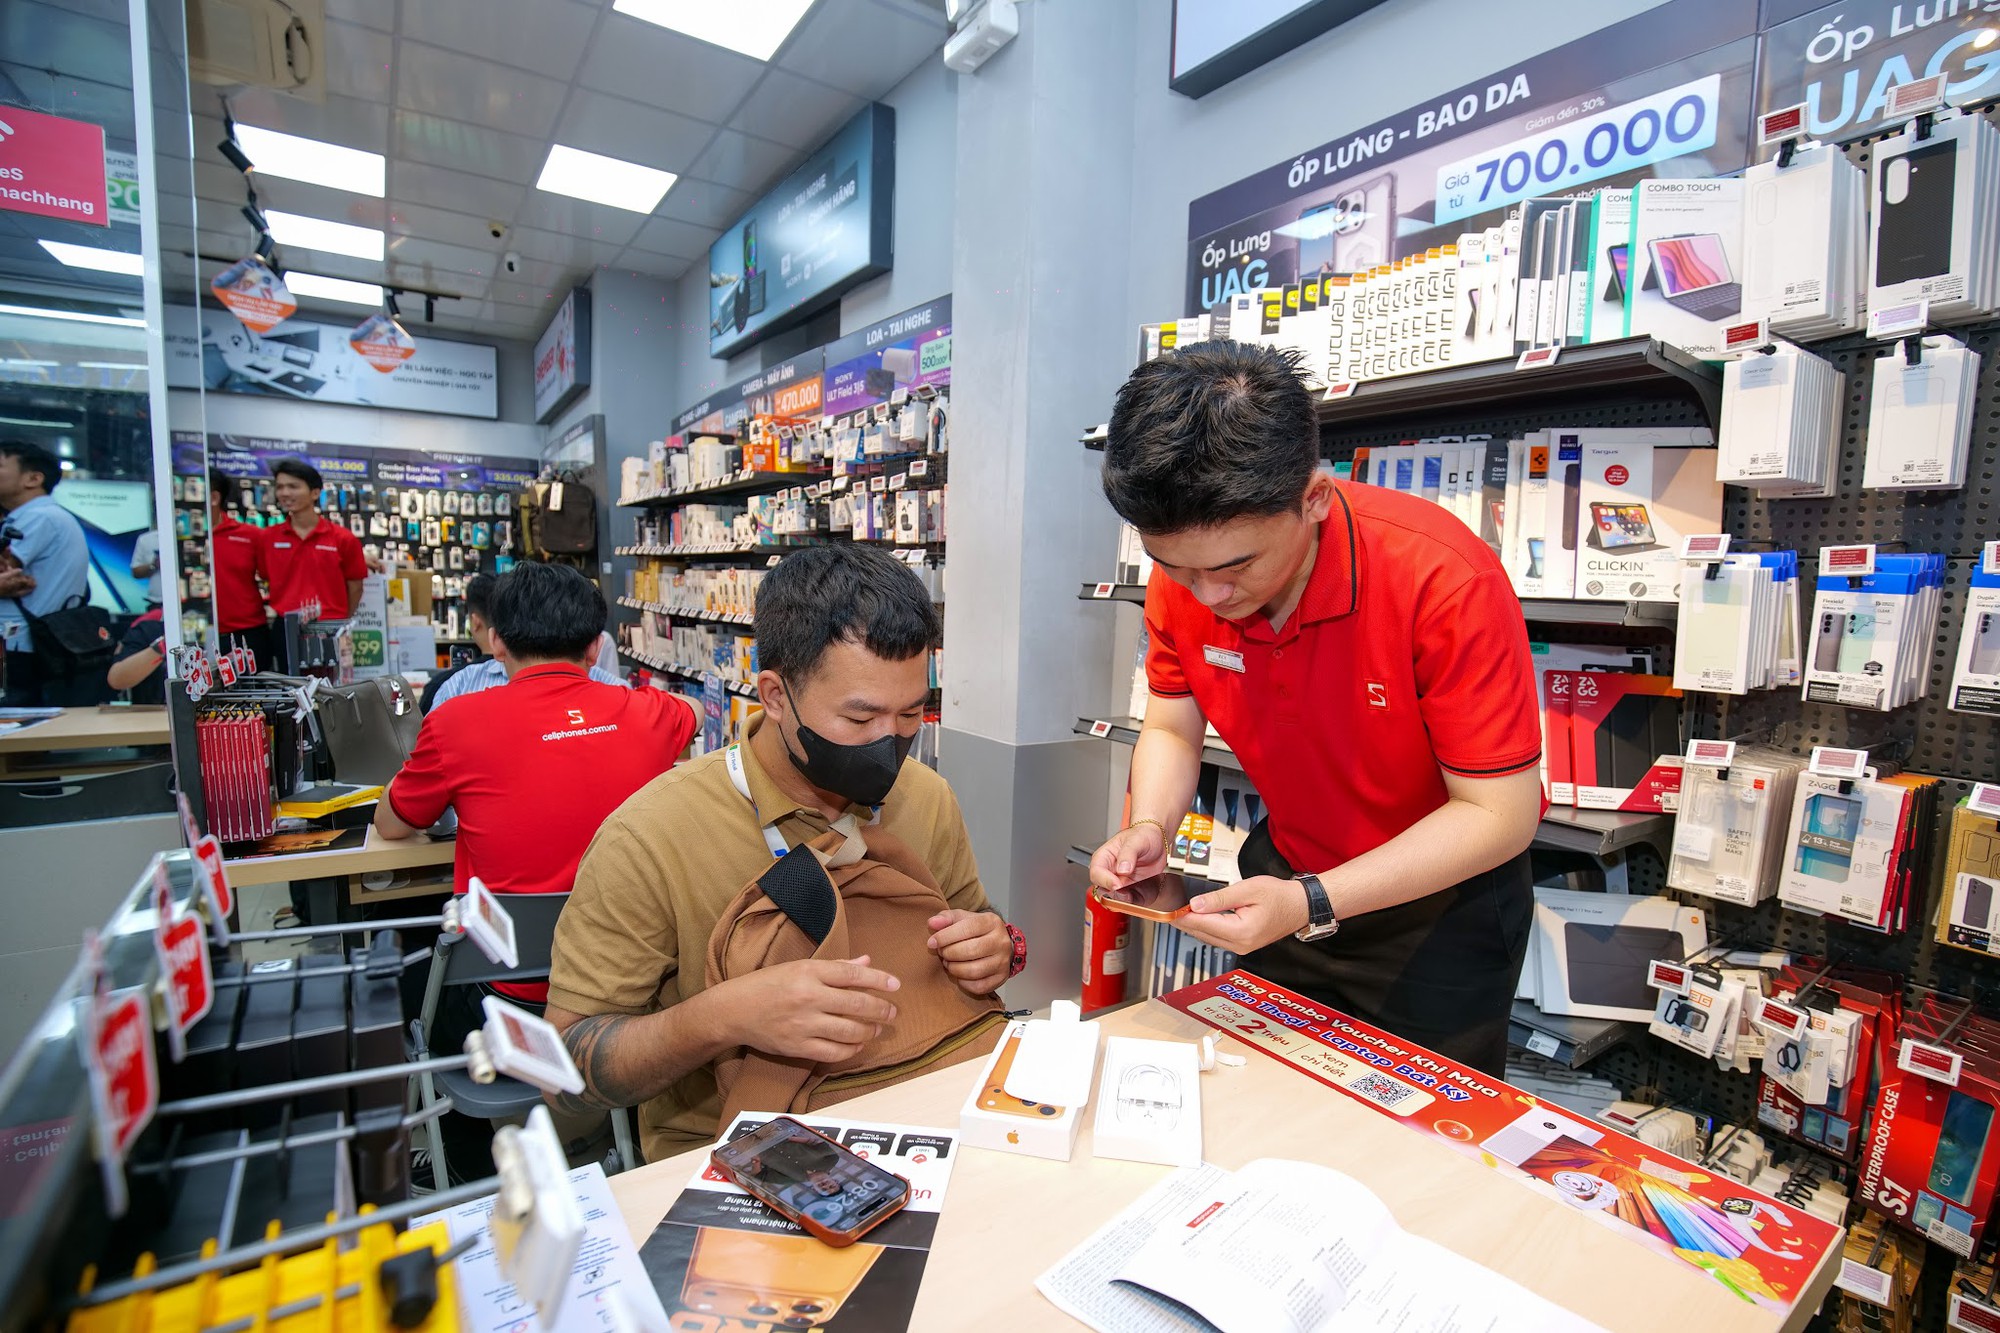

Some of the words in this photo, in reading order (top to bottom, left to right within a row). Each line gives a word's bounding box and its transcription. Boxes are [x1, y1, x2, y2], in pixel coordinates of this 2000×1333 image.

[1805, 14, 1874, 63] Ốp
[1806, 28, 2000, 136] UAG
[1581, 95, 1605, 112] 30%
[1288, 156, 1323, 189] ỐP
[1325, 128, 1394, 180] LƯNG
[1417, 93, 1479, 139] BAO
[1485, 73, 1531, 112] DA
[1475, 94, 1706, 202] 700.000
[1444, 172, 1470, 190] Giá
[1647, 184, 1684, 192] COMBO
[1686, 183, 1721, 192] TOUCH
[1449, 194, 1464, 209] từ
[1202, 239, 1226, 268] Ốp
[1230, 229, 1271, 259] Lưng
[1202, 258, 1269, 310] UAG
[866, 327, 883, 346] LOA
[889, 320, 903, 337] TAI
[904, 308, 932, 331] NGHE
[1681, 344, 1715, 355] logitech
[741, 377, 764, 396] CAMERA
[767, 369, 781, 386] MÁY
[780, 363, 795, 381] ẢNH
[834, 371, 853, 385] SONY
[780, 382, 819, 413] 470.000
[826, 388, 838, 403] ULT
[837, 382, 853, 399] Field
[1587, 560, 1644, 572] CLICKIN
[1578, 677, 1597, 687] ZA
[1577, 687, 1599, 696] GG
[542, 724, 618, 741] cellphones.com.vn
[1808, 780, 1837, 791] ZAGG
[1725, 847, 1743, 856] MAKE
[1690, 990, 1714, 1009] AG
[1214, 1012, 1236, 1025] giá
[1228, 974, 1267, 995] Tặng
[1267, 991, 1329, 1022] Combo
[1331, 1018, 1411, 1058] Voucher
[1409, 1053, 1449, 1075] Khi
[1447, 1070, 1502, 1099] Mua
[1236, 1019, 1267, 1035] 2
[1262, 1029, 1291, 1047] Triệu
[1216, 983, 1258, 1006] Điện
[1256, 1000, 1311, 1029] Thoại
[1319, 1030, 1395, 1068] Laptop
[1393, 1063, 1438, 1088] Bất
[1436, 1082, 1473, 1102] Kỳ
[1318, 1051, 1348, 1069] Xem
[1322, 1062, 1346, 1078] tiết
[1861, 1120, 1893, 1202] WATERPROOF
[1882, 1088, 1900, 1121] CASE
[724, 1196, 753, 1206] Tháng
[825, 1178, 879, 1213] 08:26
[1877, 1176, 1912, 1217] S.1
[739, 1215, 771, 1229] nhanh.
